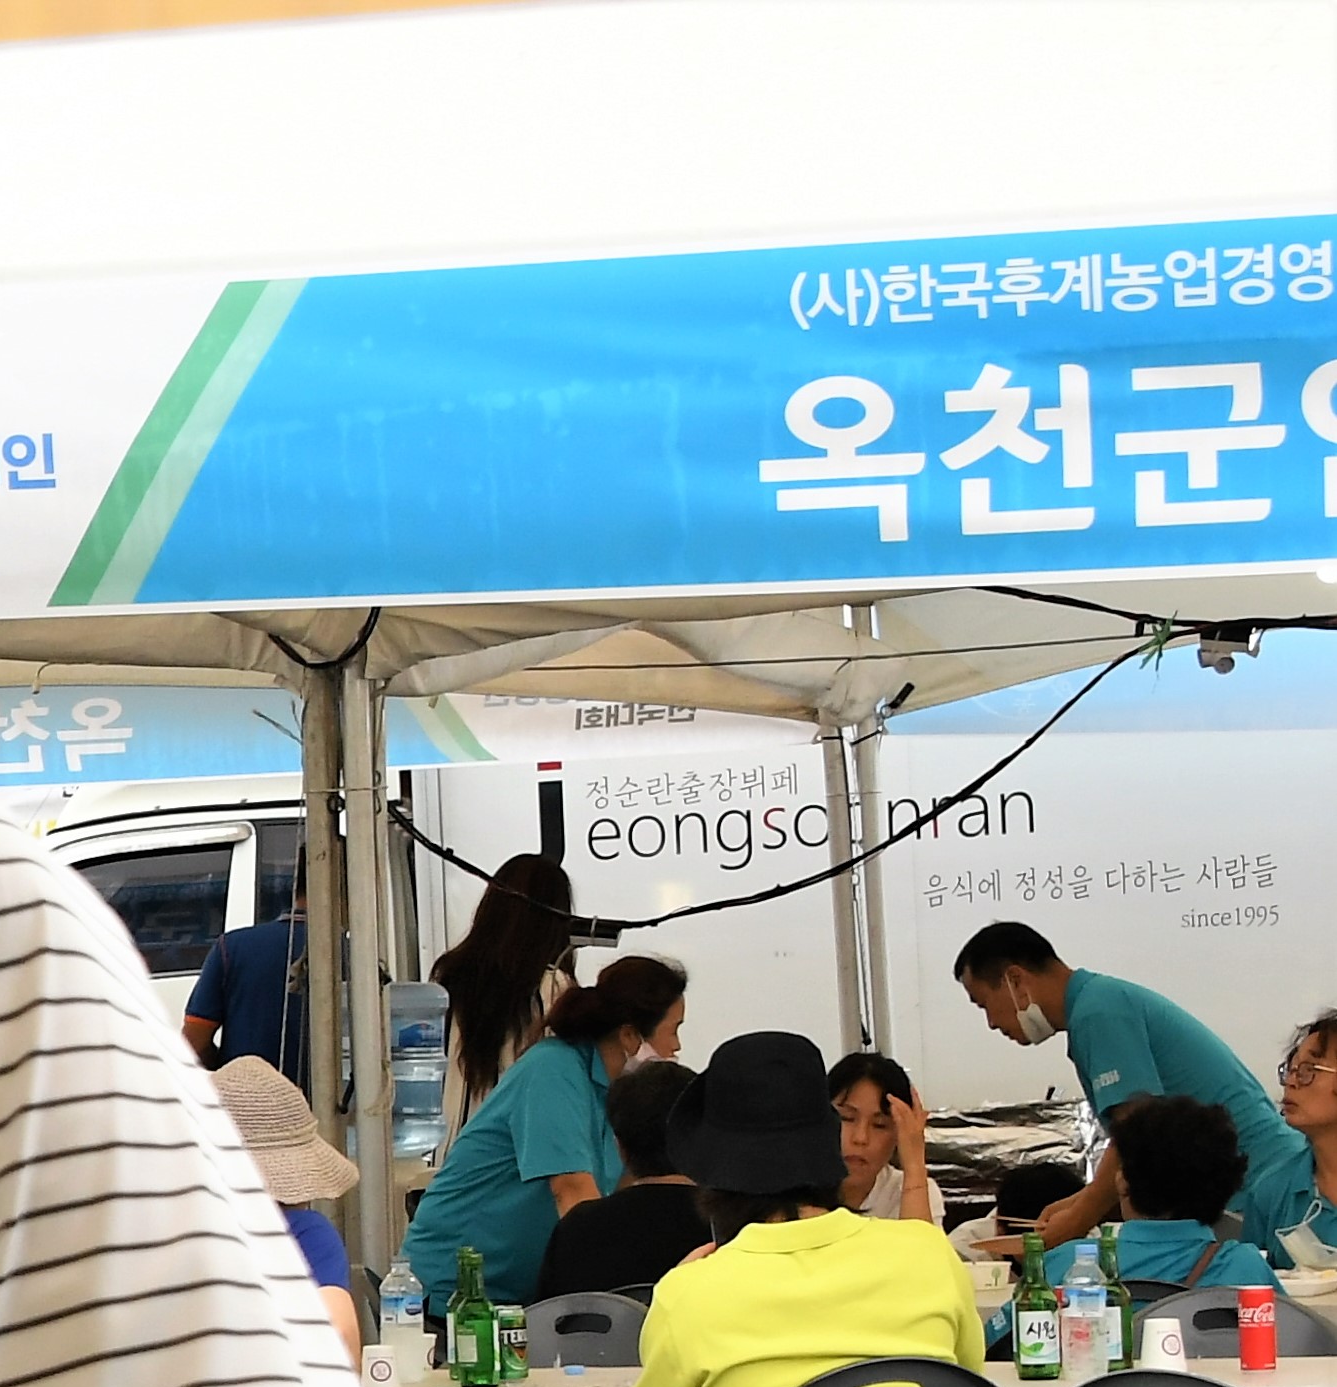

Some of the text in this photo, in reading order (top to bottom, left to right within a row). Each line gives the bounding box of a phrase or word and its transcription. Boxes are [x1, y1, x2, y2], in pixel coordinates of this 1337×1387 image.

[758, 361, 1337, 543] 옥천군
[585, 763, 799, 810] 정순란출장뷔페
[923, 853, 1278, 908] 음식에 정성을 다하는 사람들
[1026, 1320, 1057, 1339] 시원
